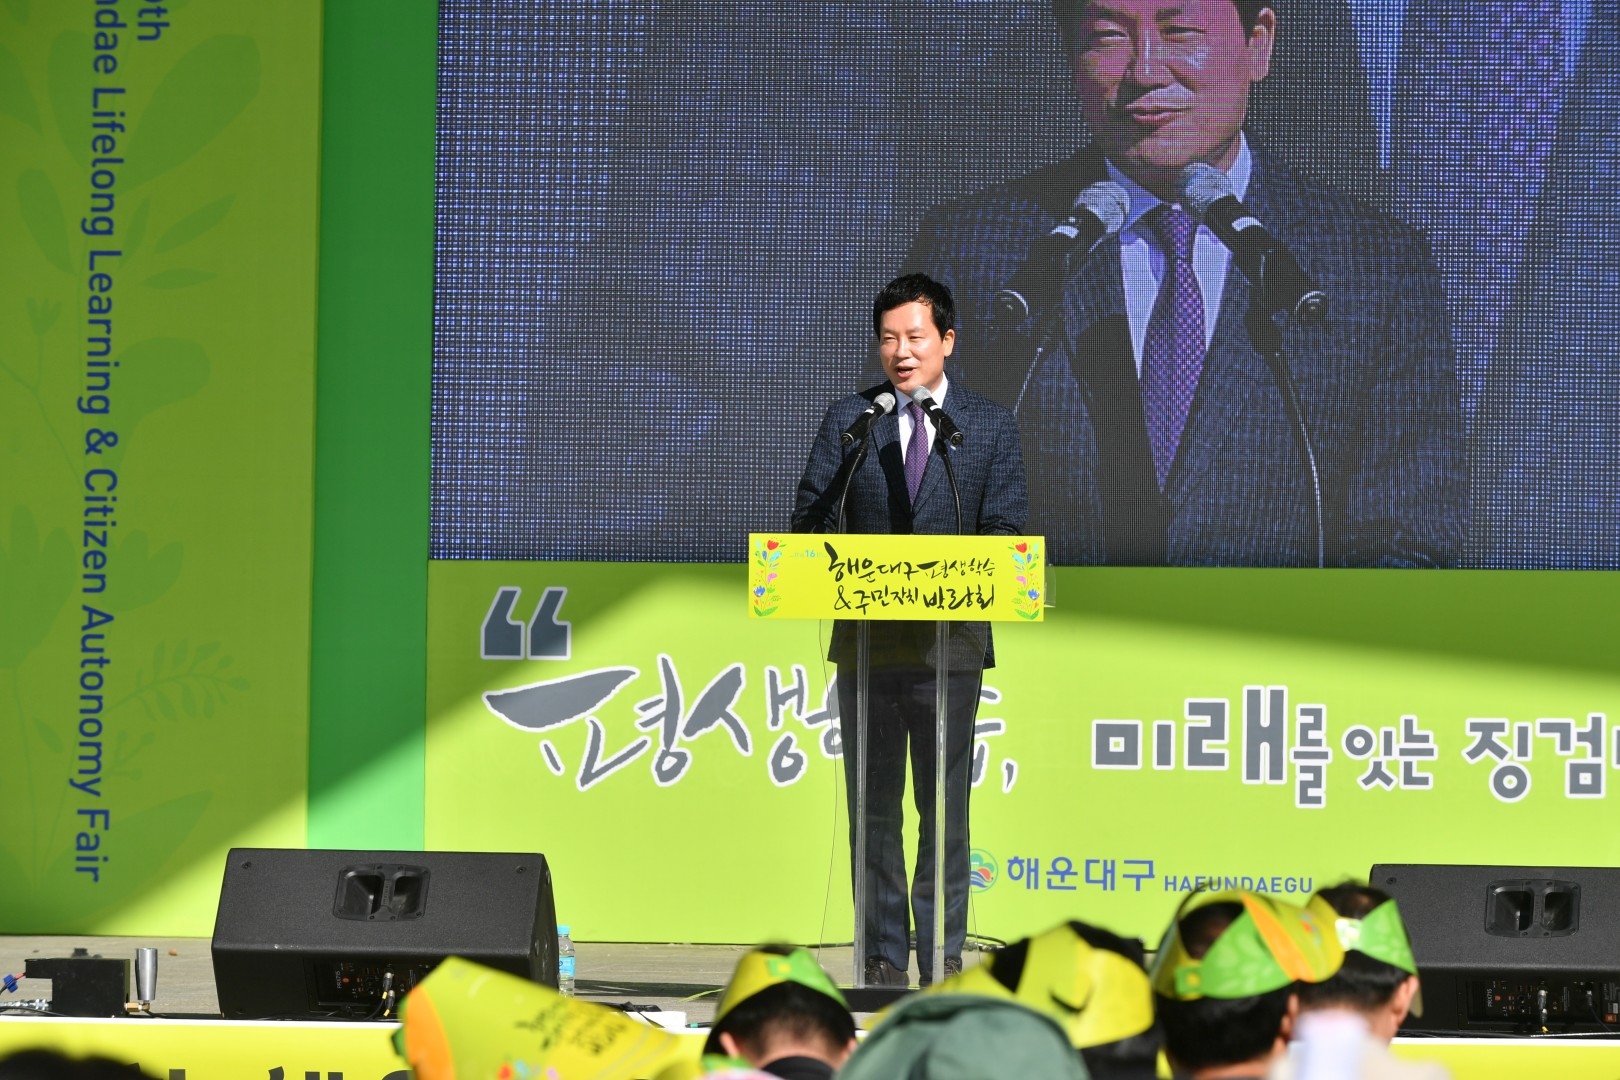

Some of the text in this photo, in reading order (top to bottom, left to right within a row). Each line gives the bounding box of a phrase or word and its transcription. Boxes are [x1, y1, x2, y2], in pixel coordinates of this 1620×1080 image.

[137, 0, 170, 41] th
[69, 0, 127, 883] dae Lifelong Learning & Citizen Autonomy Fair
[824, 541, 996, 583] 해운대구 평생학습
[923, 583, 995, 611] 박람회
[1093, 687, 1331, 807] 미래를
[1343, 716, 1436, 789] 잇는
[1464, 713, 1620, 801] 징검
[1007, 856, 1313, 893] 해운대구 HAEUNDAEGU
